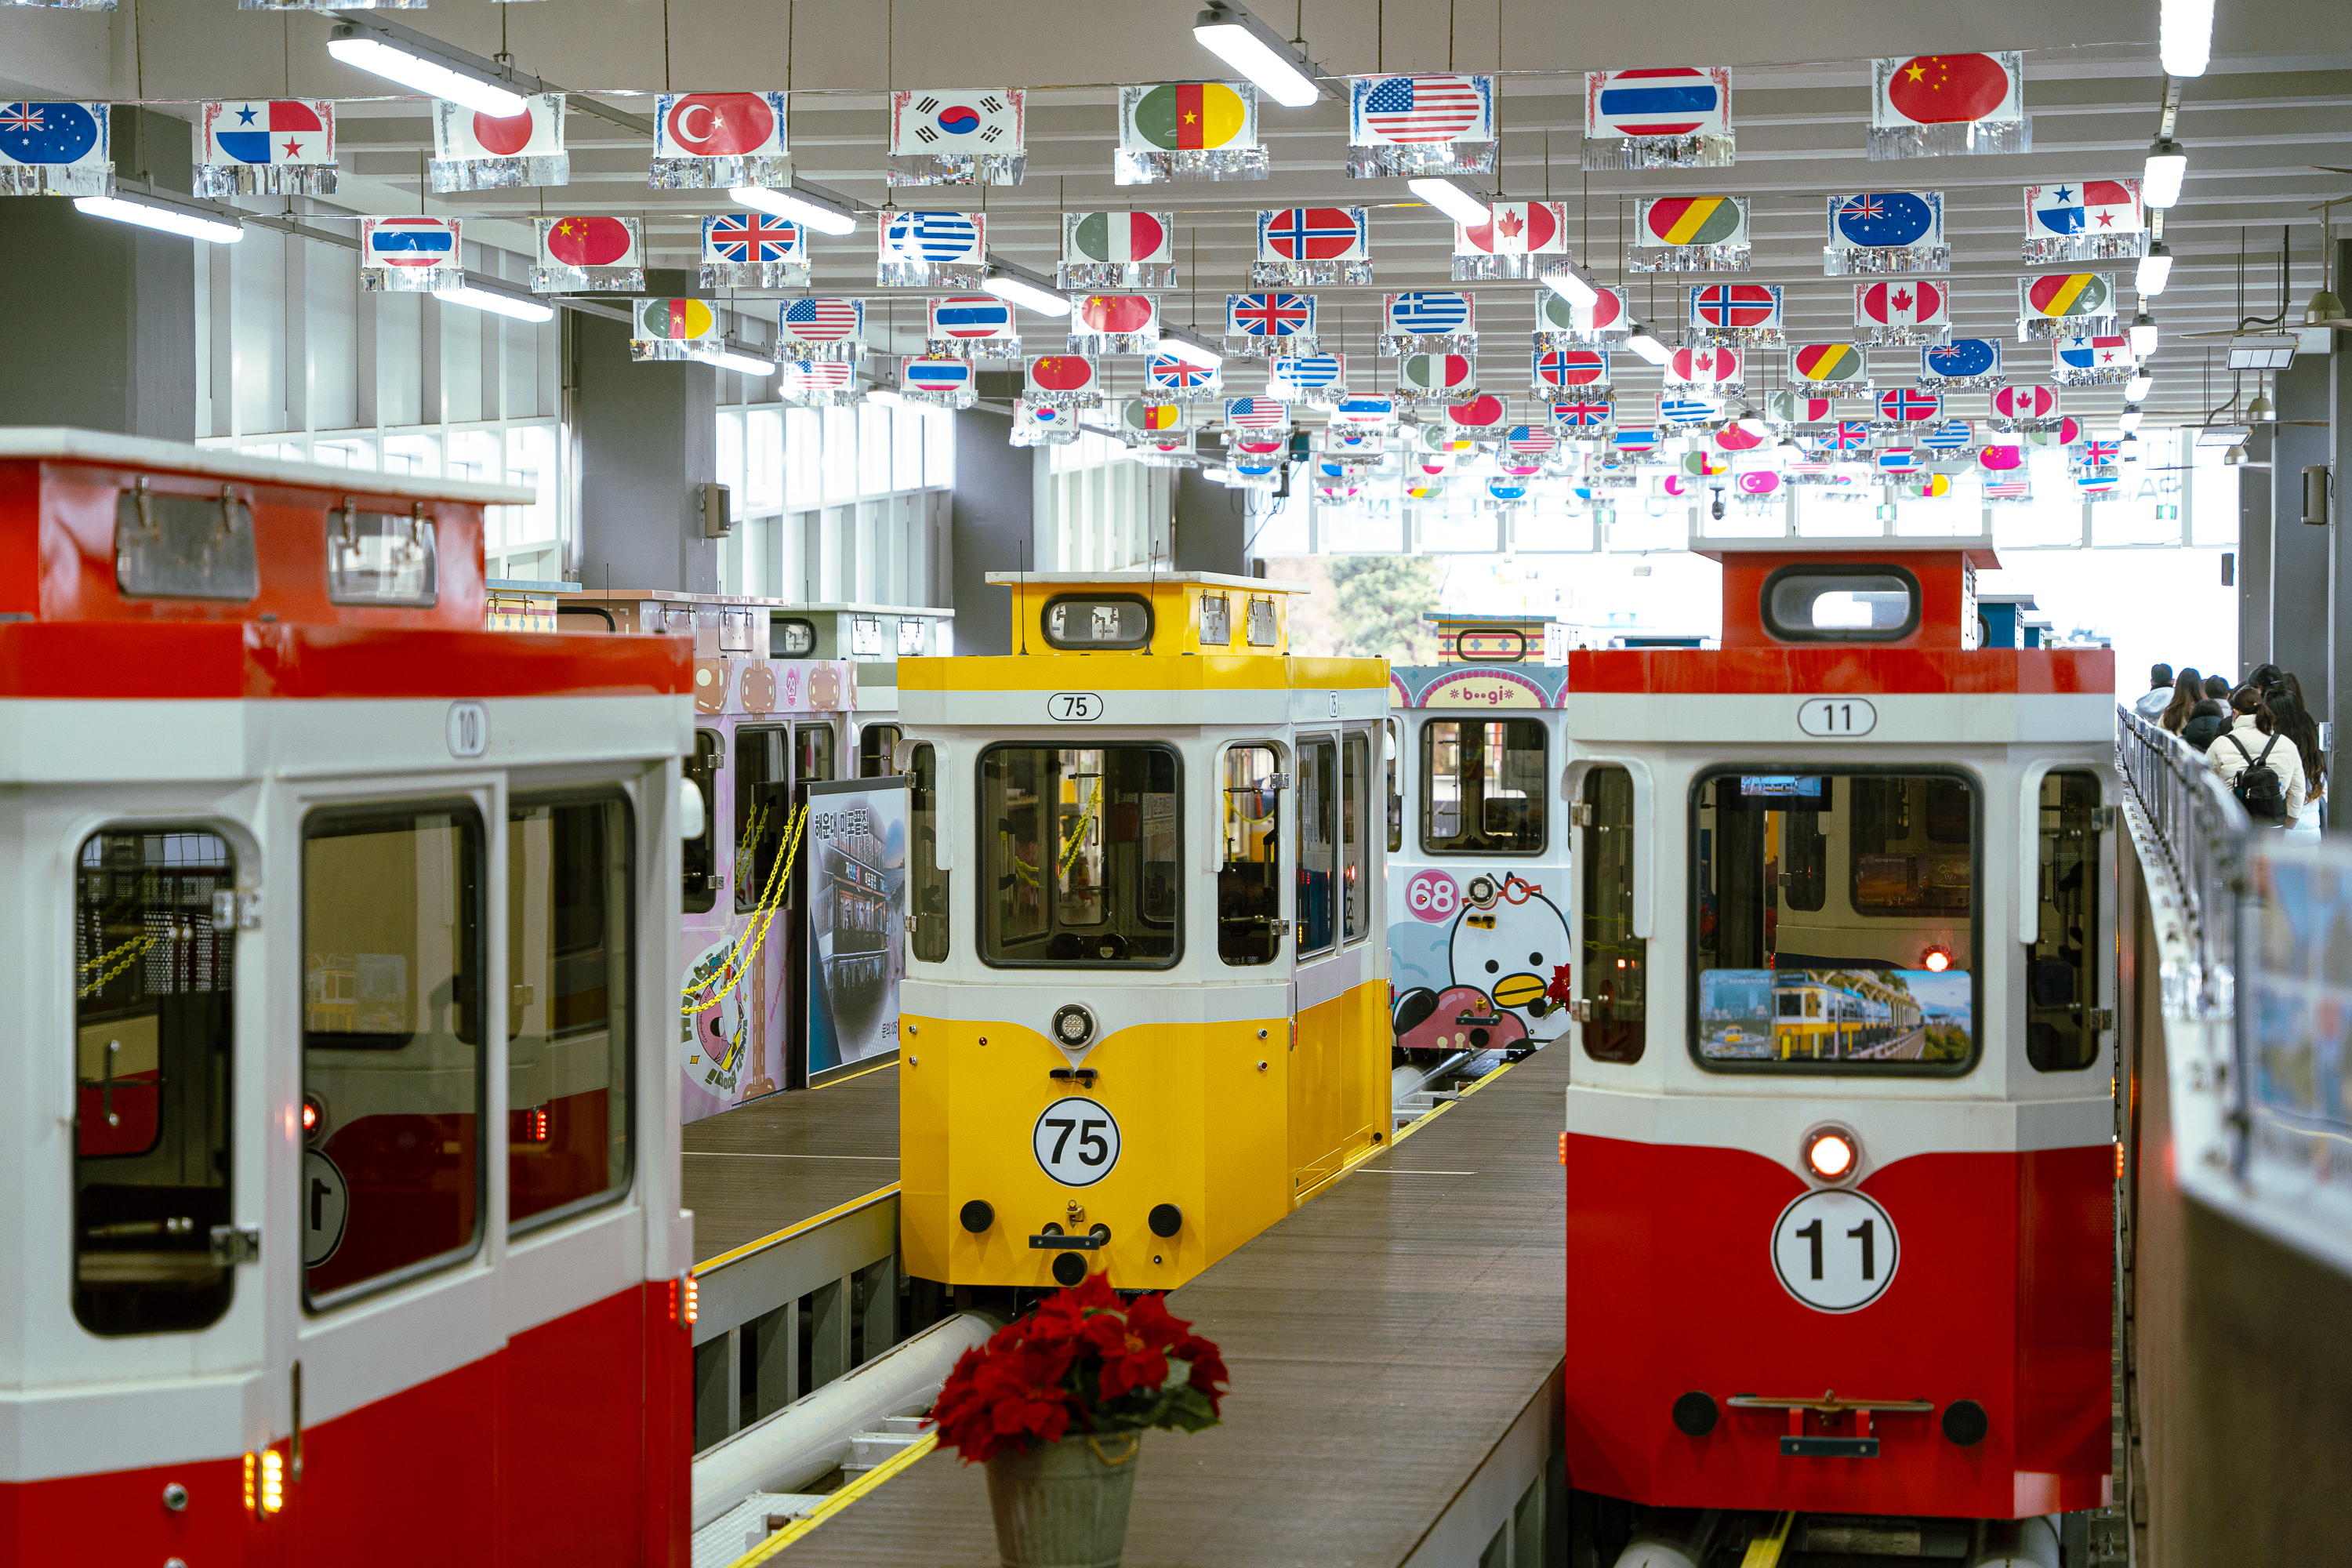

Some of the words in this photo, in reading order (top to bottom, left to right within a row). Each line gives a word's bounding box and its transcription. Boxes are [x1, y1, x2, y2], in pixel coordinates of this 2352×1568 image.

[787, 677, 796, 695] 29
[1063, 697, 1087, 717] 75
[1824, 704, 1850, 731] 11
[457, 710, 477, 750] 10
[815, 810, 837, 841] 해운대
[1410, 878, 1454, 913] 68
[1045, 1119, 1109, 1167] 75
[1795, 1218, 1875, 1281] 11
